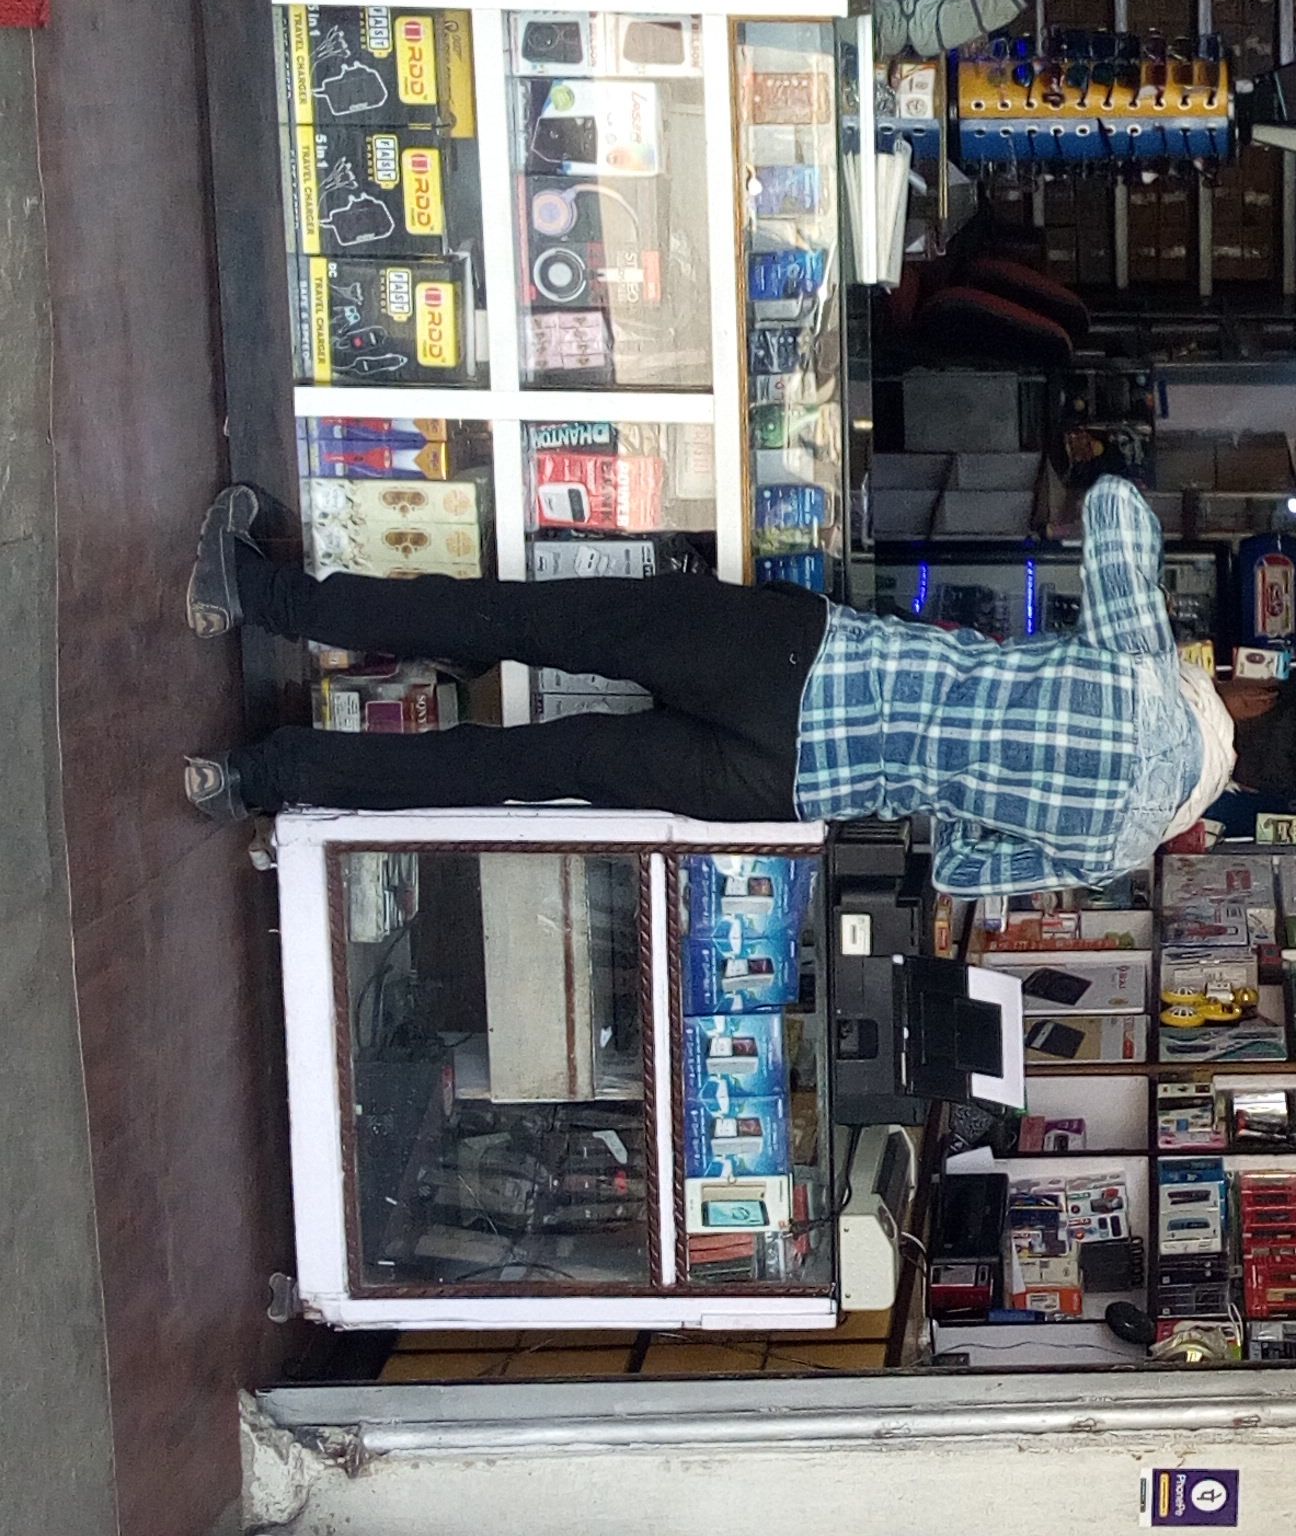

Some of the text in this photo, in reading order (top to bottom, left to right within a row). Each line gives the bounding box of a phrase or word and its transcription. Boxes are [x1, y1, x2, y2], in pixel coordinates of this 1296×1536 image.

[294, 13, 308, 105] TRAVEL CHARGER
[315, 133, 327, 143] 5
[316, 145, 328, 159] in
[376, 139, 395, 180] FAST
[301, 145, 315, 235] TRAVEL CHARGER
[389, 273, 408, 312] FAST
[314, 276, 326, 364] TRAVEL CHARGER
[415, 694, 428, 724] SONY
[1174, 1474, 1187, 1517] PhonePe
